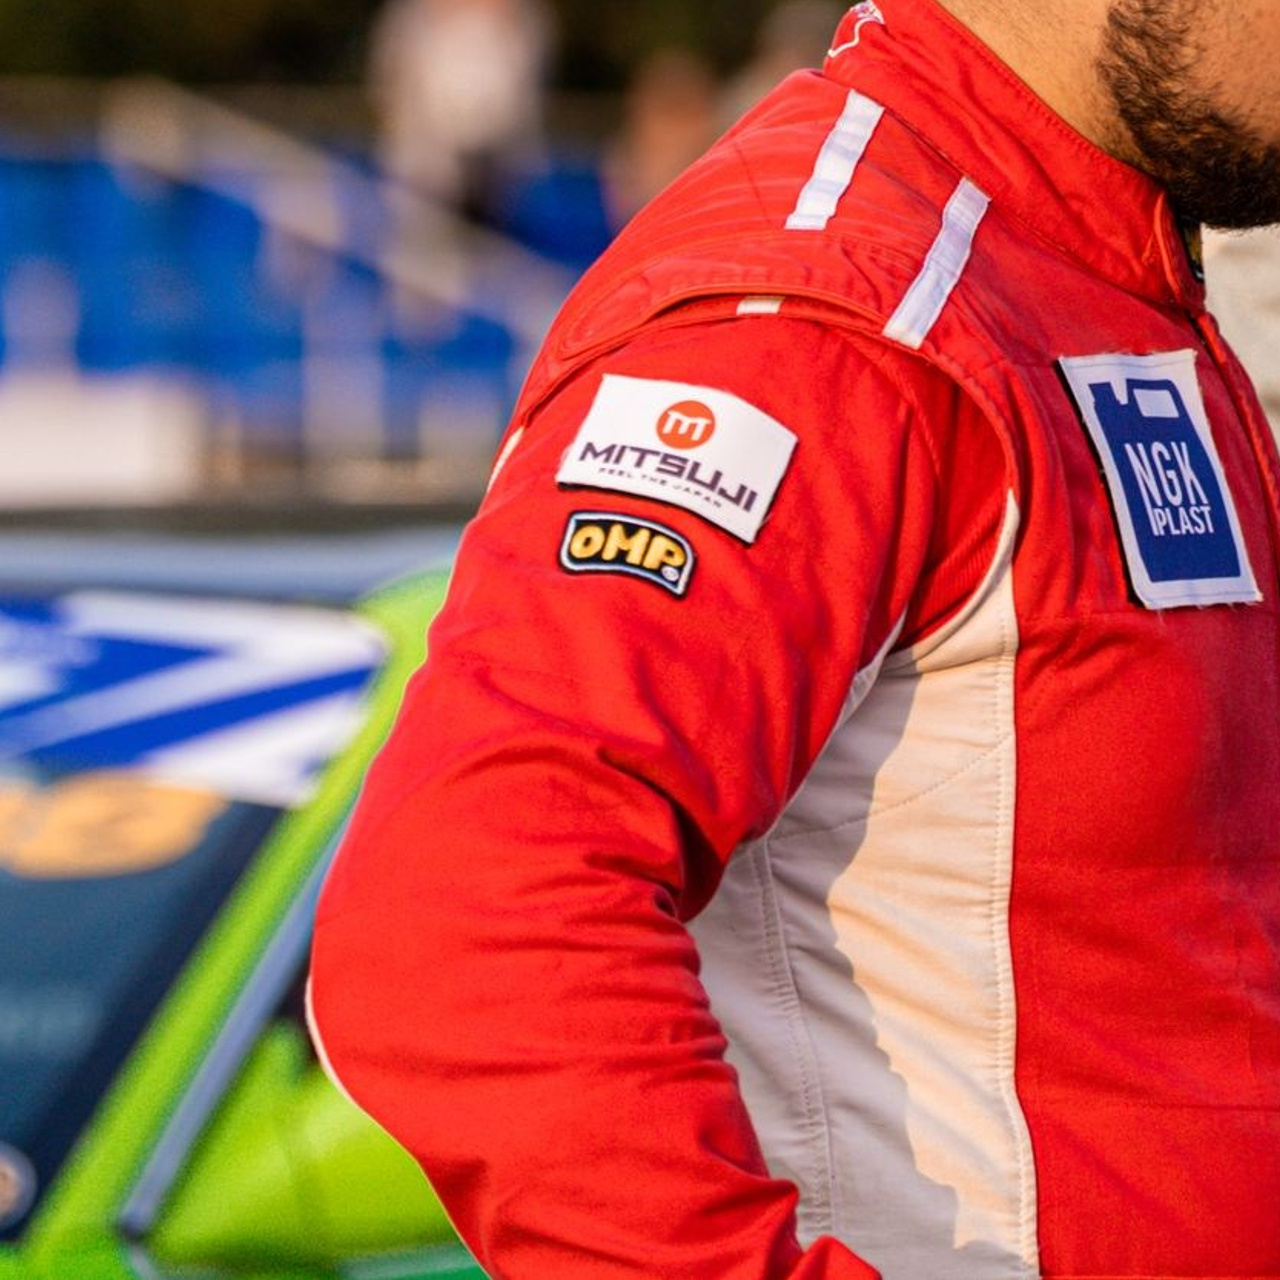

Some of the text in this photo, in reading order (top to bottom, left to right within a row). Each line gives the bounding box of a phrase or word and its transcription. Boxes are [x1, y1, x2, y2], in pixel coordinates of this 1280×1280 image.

[578, 441, 758, 513] MITSUJI
[673, 483, 723, 508] JAPAN
[1124, 441, 1209, 510] NGK
[1154, 506, 1215, 537] PLAST
[569, 524, 686, 571] OMP
